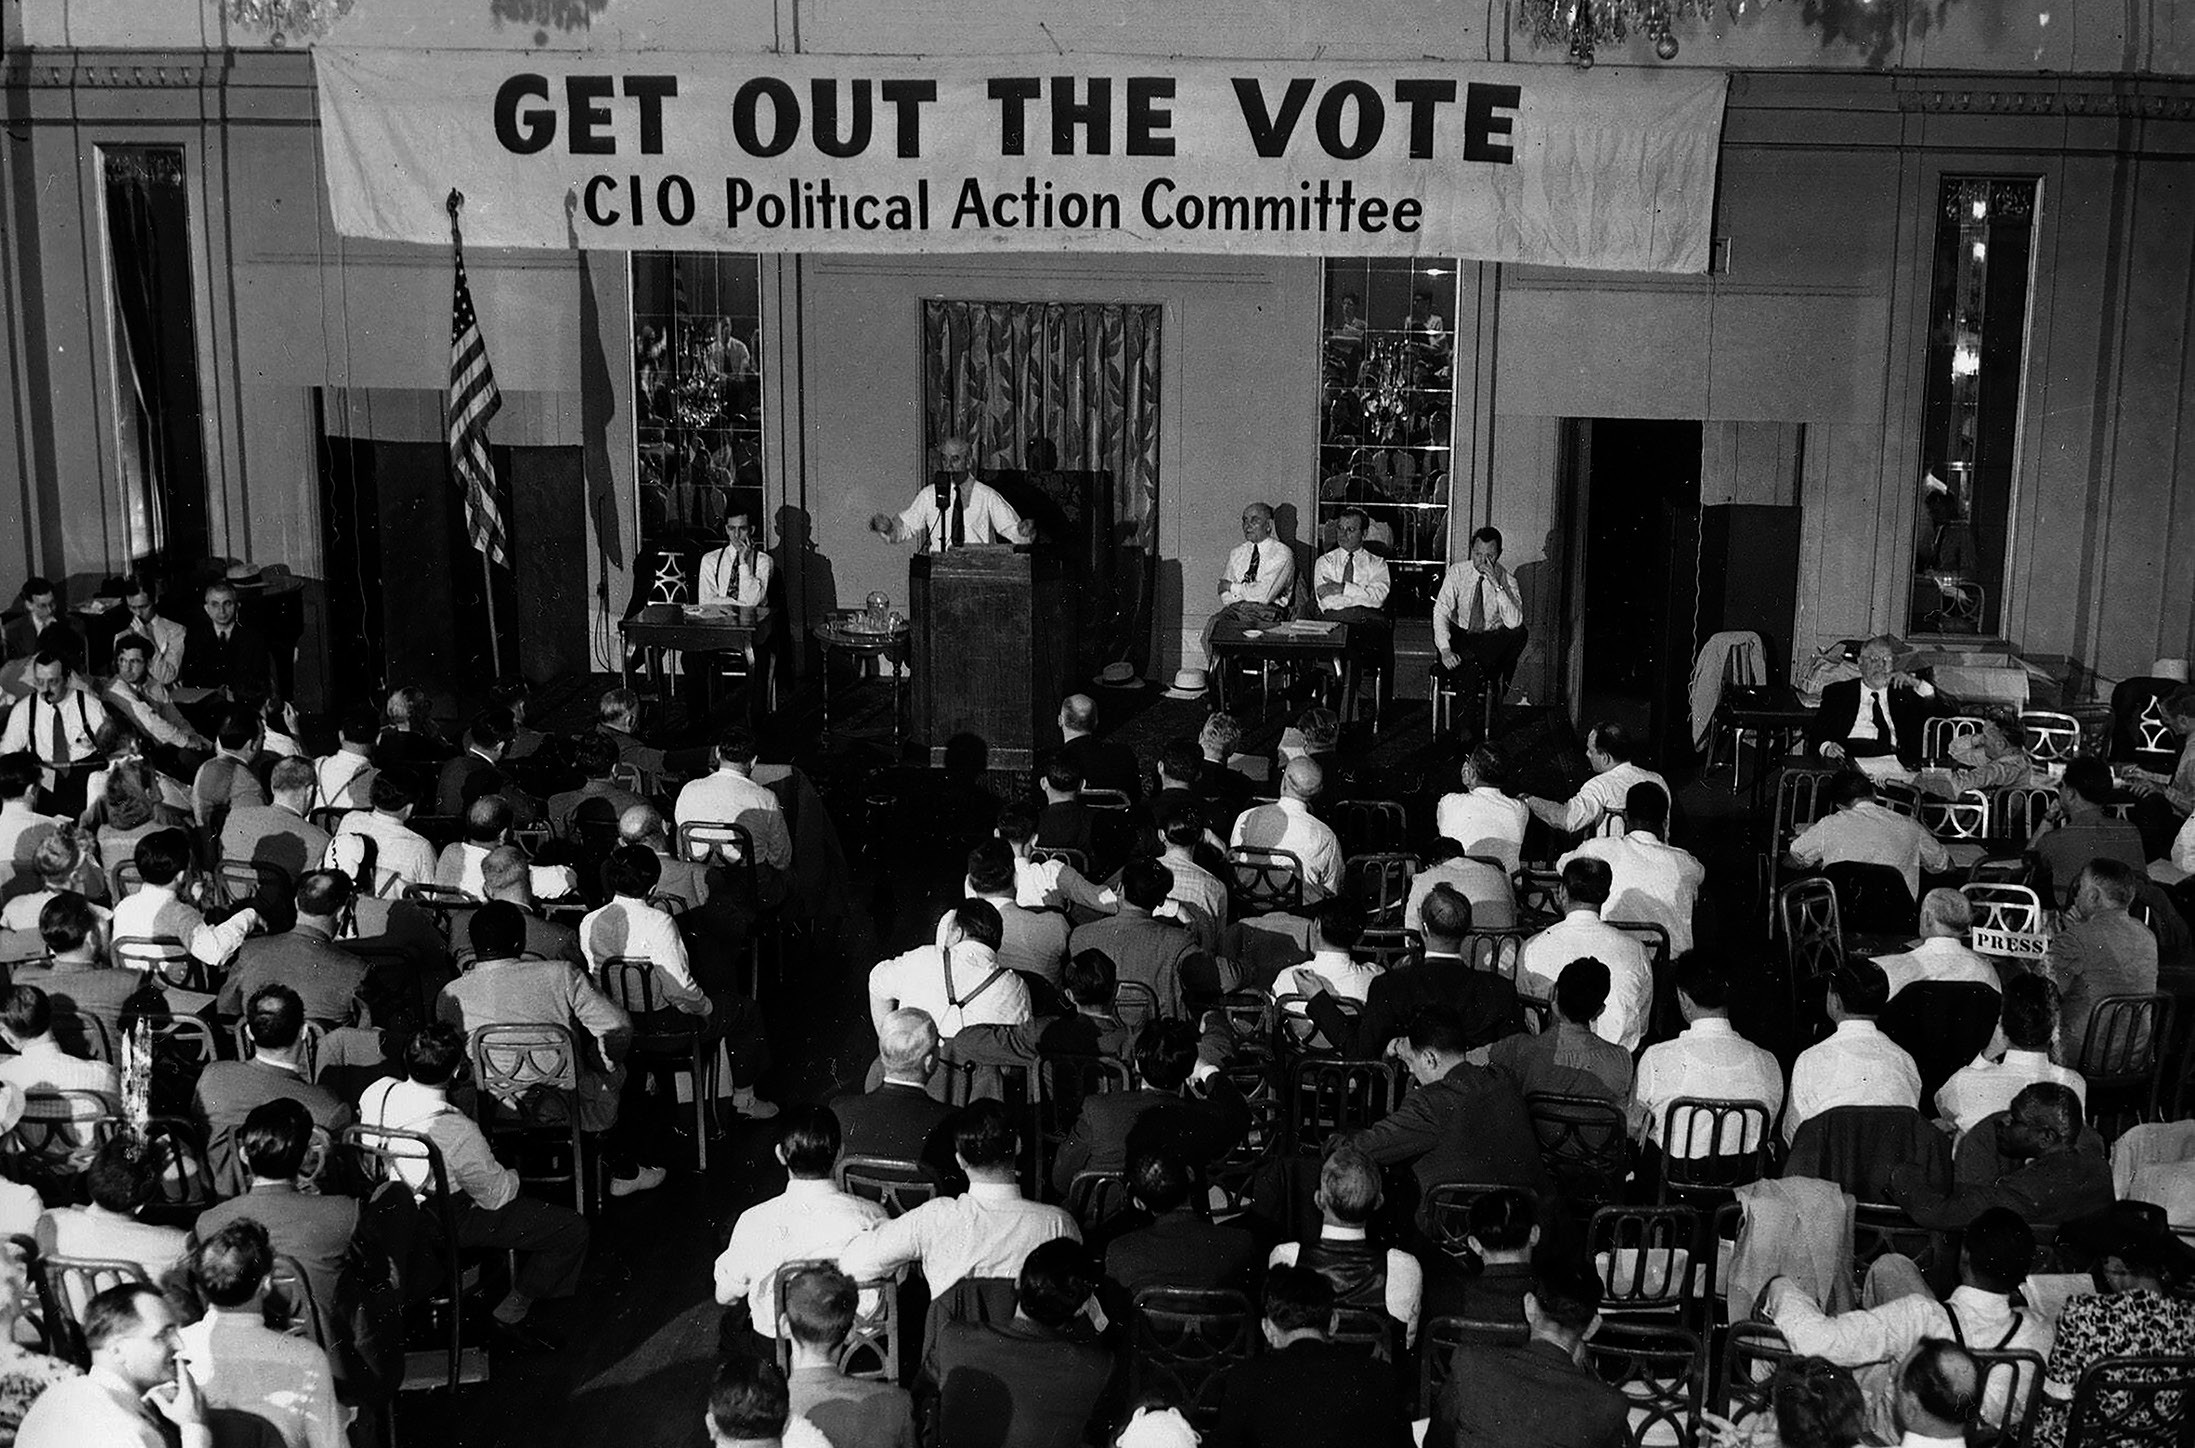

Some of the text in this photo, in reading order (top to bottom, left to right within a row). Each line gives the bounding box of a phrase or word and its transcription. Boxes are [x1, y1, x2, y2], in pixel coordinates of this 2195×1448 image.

[493, 73, 1522, 165] GET OUT THE VOTE
[583, 174, 1423, 233] CIO Political Action Committee
[1976, 933, 2044, 953] PRESS
